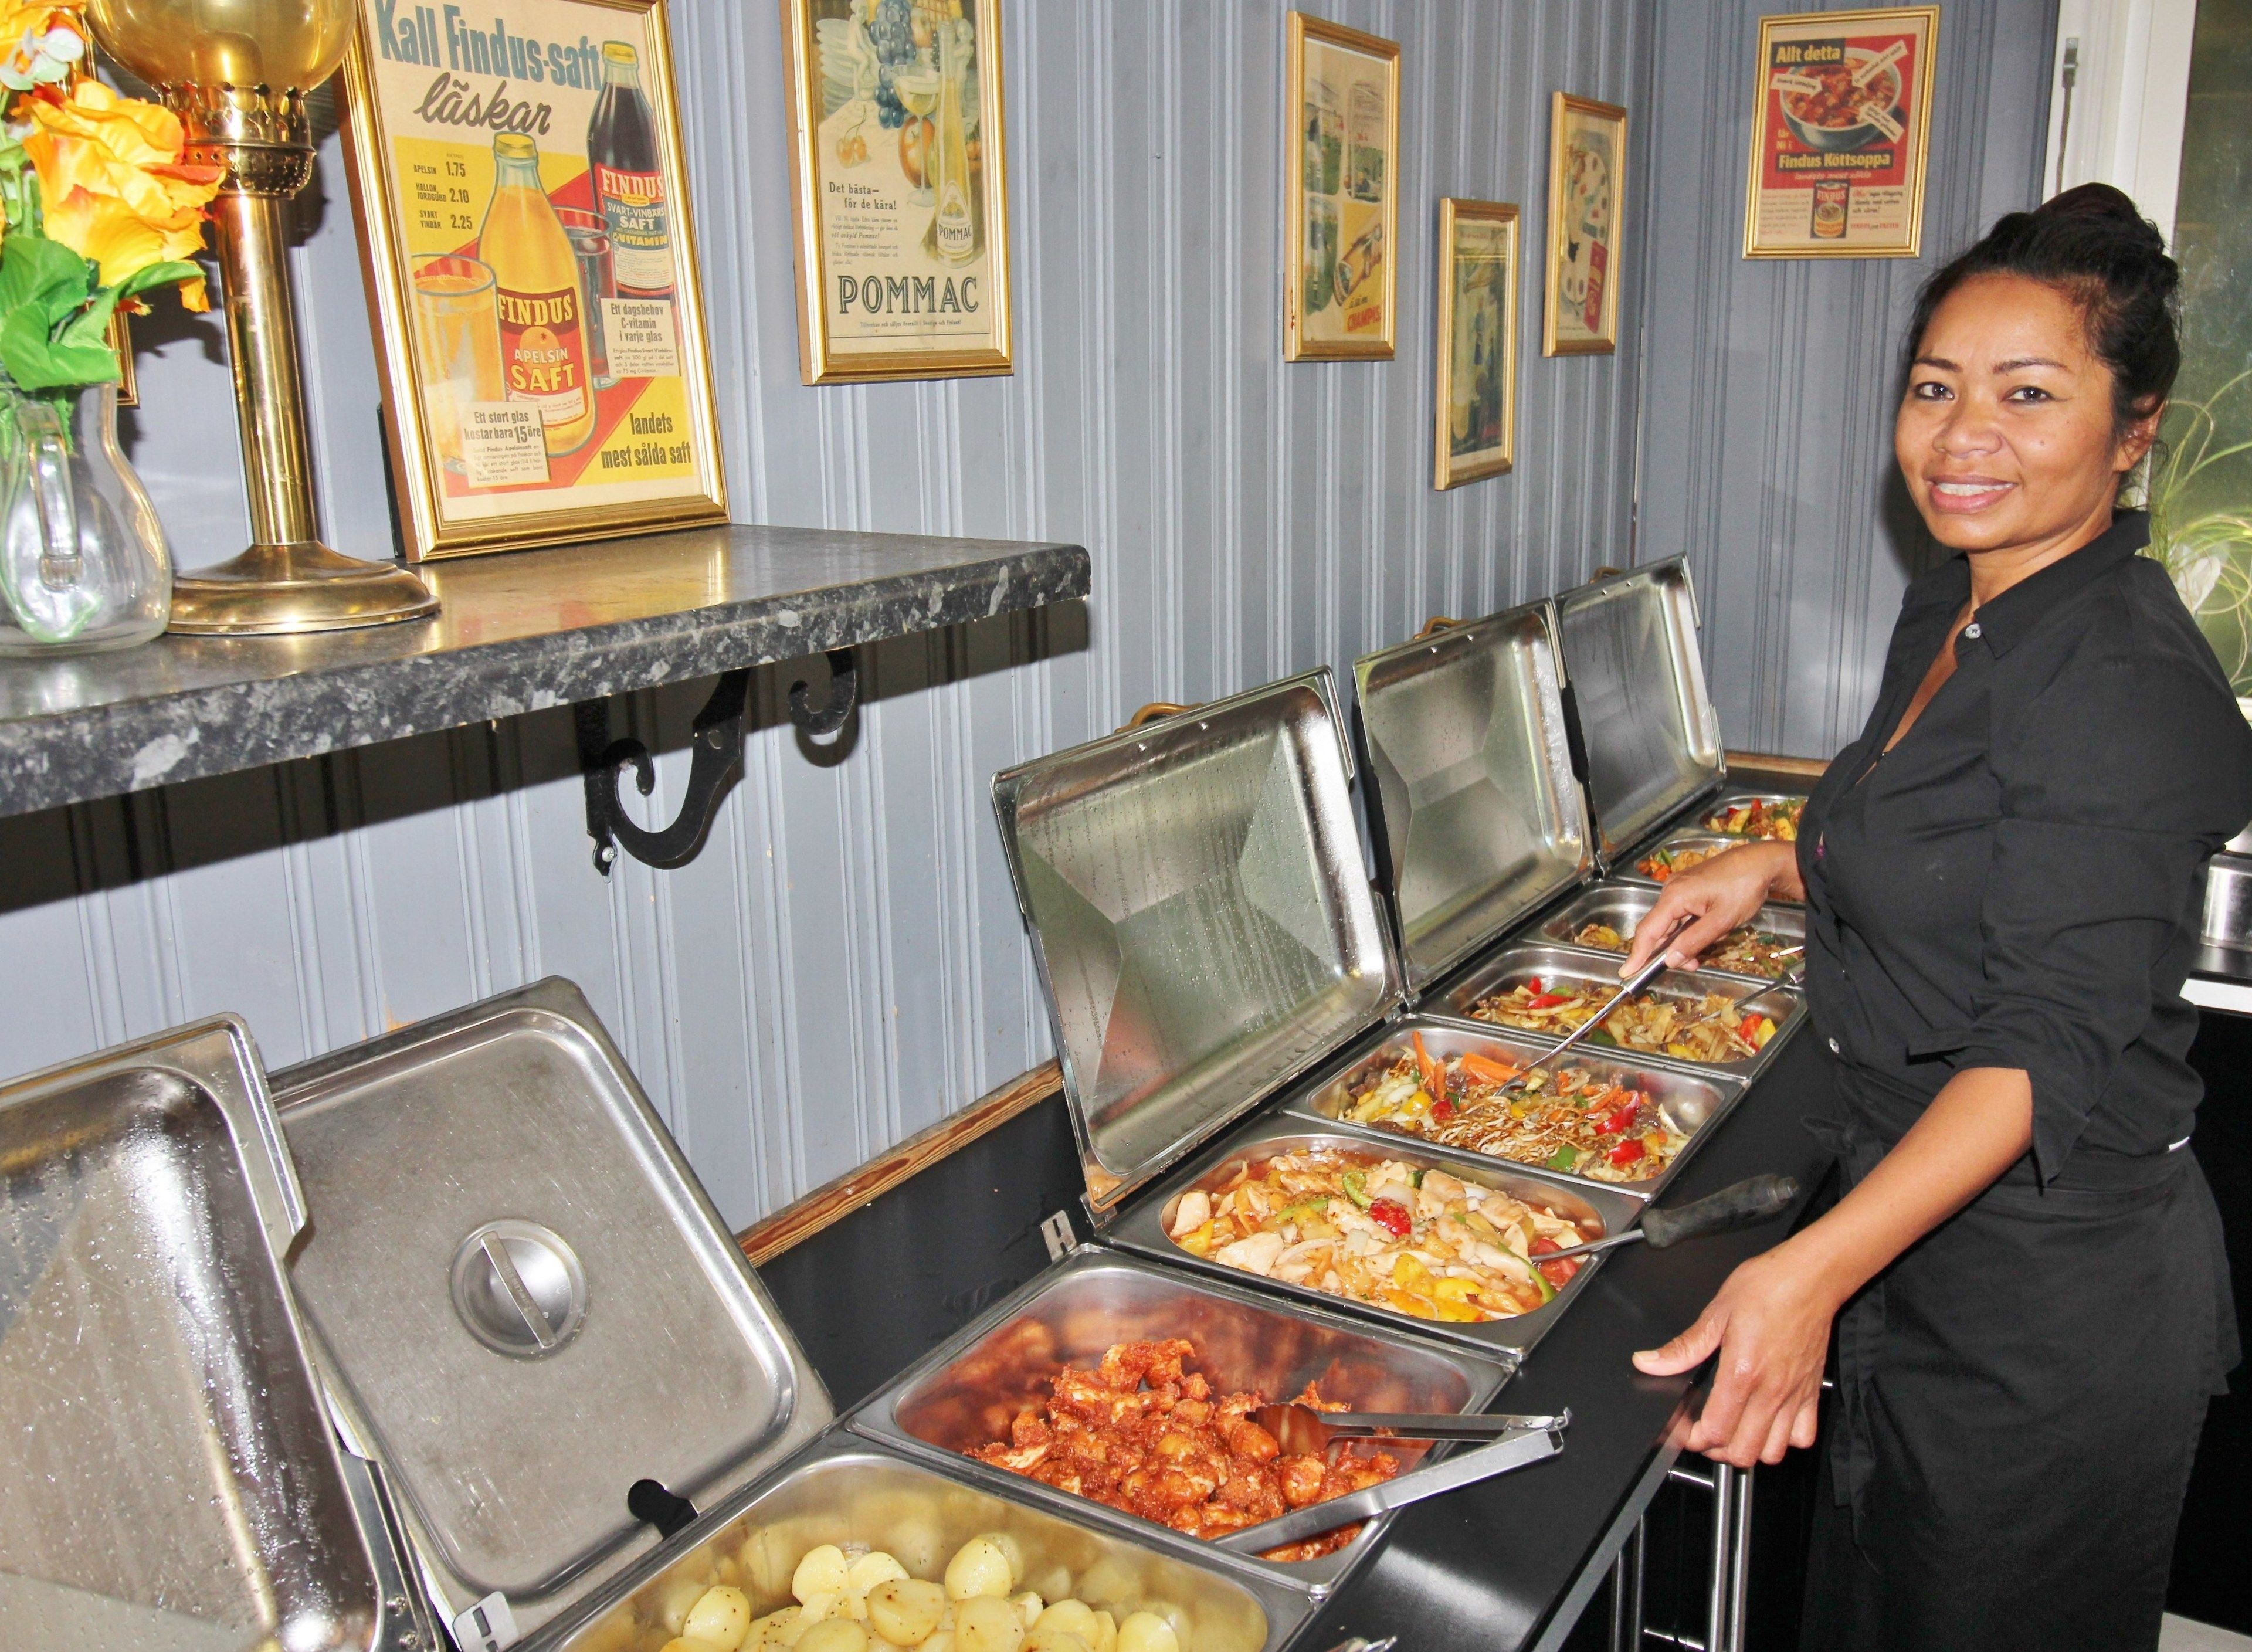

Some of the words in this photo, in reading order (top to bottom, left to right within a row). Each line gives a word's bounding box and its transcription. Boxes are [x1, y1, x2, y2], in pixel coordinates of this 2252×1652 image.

[374, 0, 441, 68] Kall
[443, 4, 603, 91] Findus-saft
[1775, 45, 1802, 63] Allt
[1803, 44, 1841, 62] detta
[413, 72, 552, 135] läskar
[413, 164, 437, 175] APELSIN
[446, 161, 466, 177] 1.75
[1778, 154, 1822, 169] Findus
[1824, 152, 1890, 169] Köttsoppa
[600, 167, 665, 199] FINDUS
[829, 181, 845, 193] Det
[417, 191, 447, 202] JORDGUBB
[449, 188, 470, 203] 2.10
[844, 197, 857, 208] för
[860, 198, 870, 209] de
[874, 199, 896, 210] kära!
[419, 209, 437, 219] SVART
[450, 214, 473, 230] 2.25
[619, 215, 654, 230] SAFT
[938, 223, 972, 240] POMMAC
[837, 275, 979, 314] POMMAC
[498, 293, 573, 326] FINDUS
[611, 303, 621, 315] Ett
[623, 303, 664, 317] dagsbehov
[621, 317, 657, 329] C-vitamin
[619, 330, 623, 341] i
[624, 330, 645, 343] varje
[646, 330, 663, 343] glas
[514, 347, 569, 364] APELSIN
[511, 362, 574, 392] SAFT
[474, 411, 486, 424] Ett
[489, 411, 510, 423] stort
[511, 411, 530, 424] glas
[629, 412, 673, 435] landets
[464, 428, 493, 440] kostar
[493, 426, 514, 439] bara
[514, 426, 528, 443] 15
[528, 425, 541, 437] öre
[601, 445, 632, 469] mest
[634, 442, 667, 466] sålda
[669, 440, 691, 464] saft
